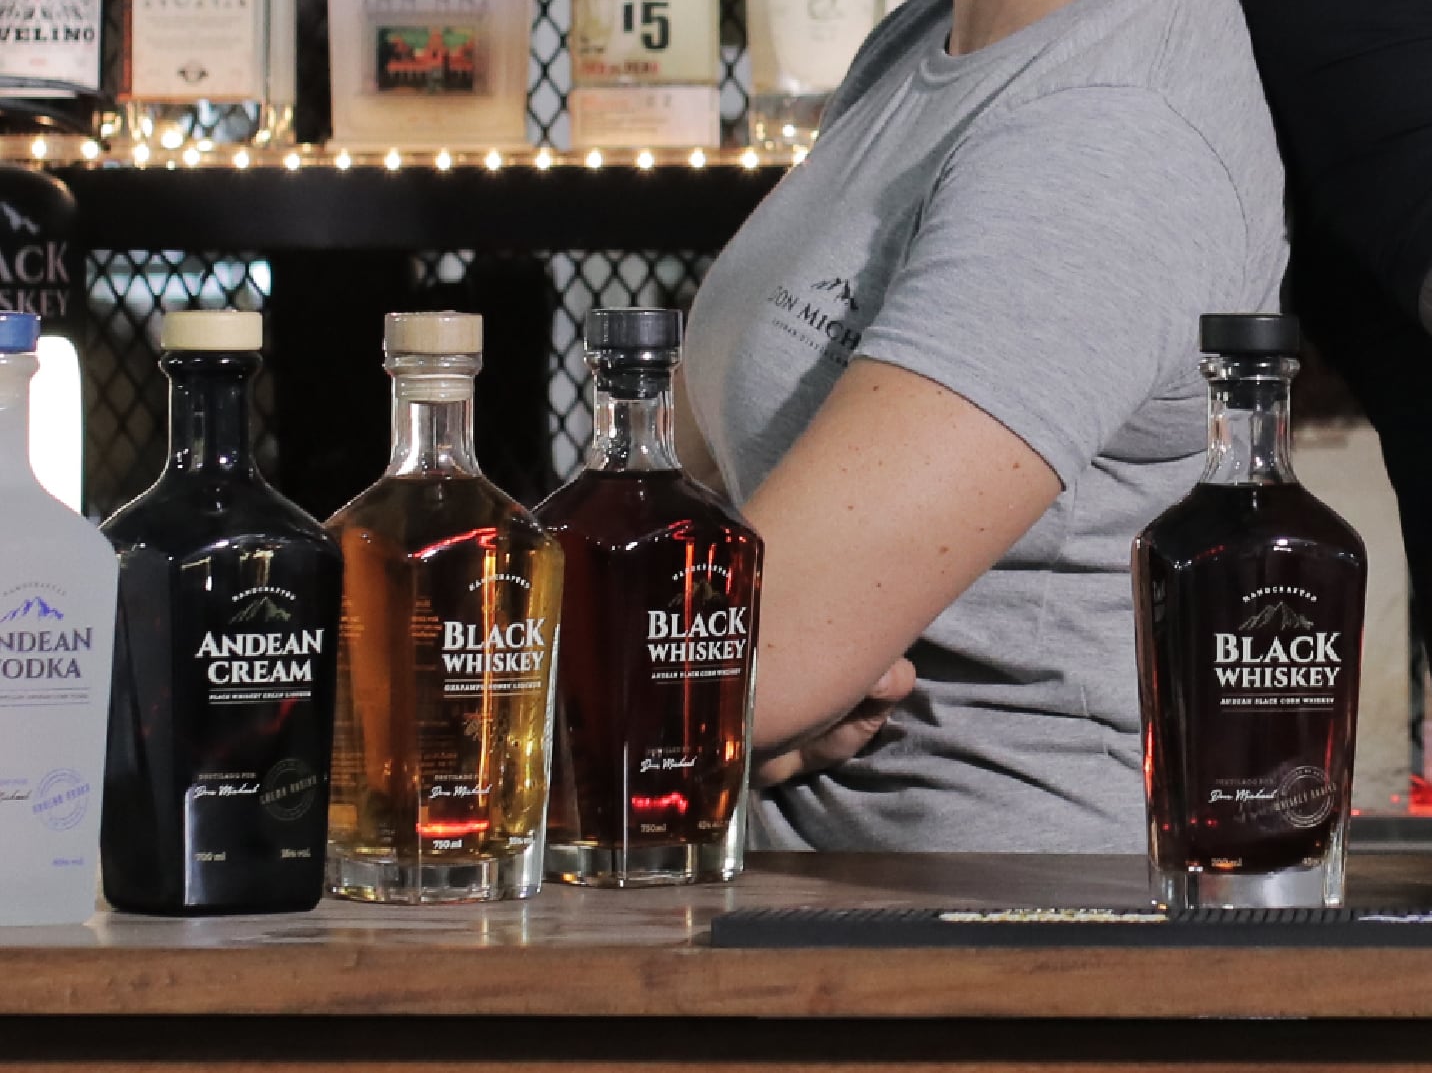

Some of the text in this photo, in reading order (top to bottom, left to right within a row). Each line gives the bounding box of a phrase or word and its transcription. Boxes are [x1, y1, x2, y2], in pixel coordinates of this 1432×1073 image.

[0, 26, 95, 42] VELINO
[623, 1, 670, 51] 15
[0, 241, 70, 284] ACK
[797, 303, 862, 351] MICH
[441, 618, 546, 650] BLACK
[647, 606, 747, 639] BLACK
[0, 627, 93, 652] NDEAN
[194, 627, 326, 658] ANDEAN
[647, 639, 747, 663] WHISKEY
[1213, 632, 1342, 664] BLACK
[0, 658, 82, 679] ODKA
[207, 659, 313, 685] CREAM
[441, 650, 546, 674] WHISKEY
[1214, 666, 1342, 688] WHISKEY
